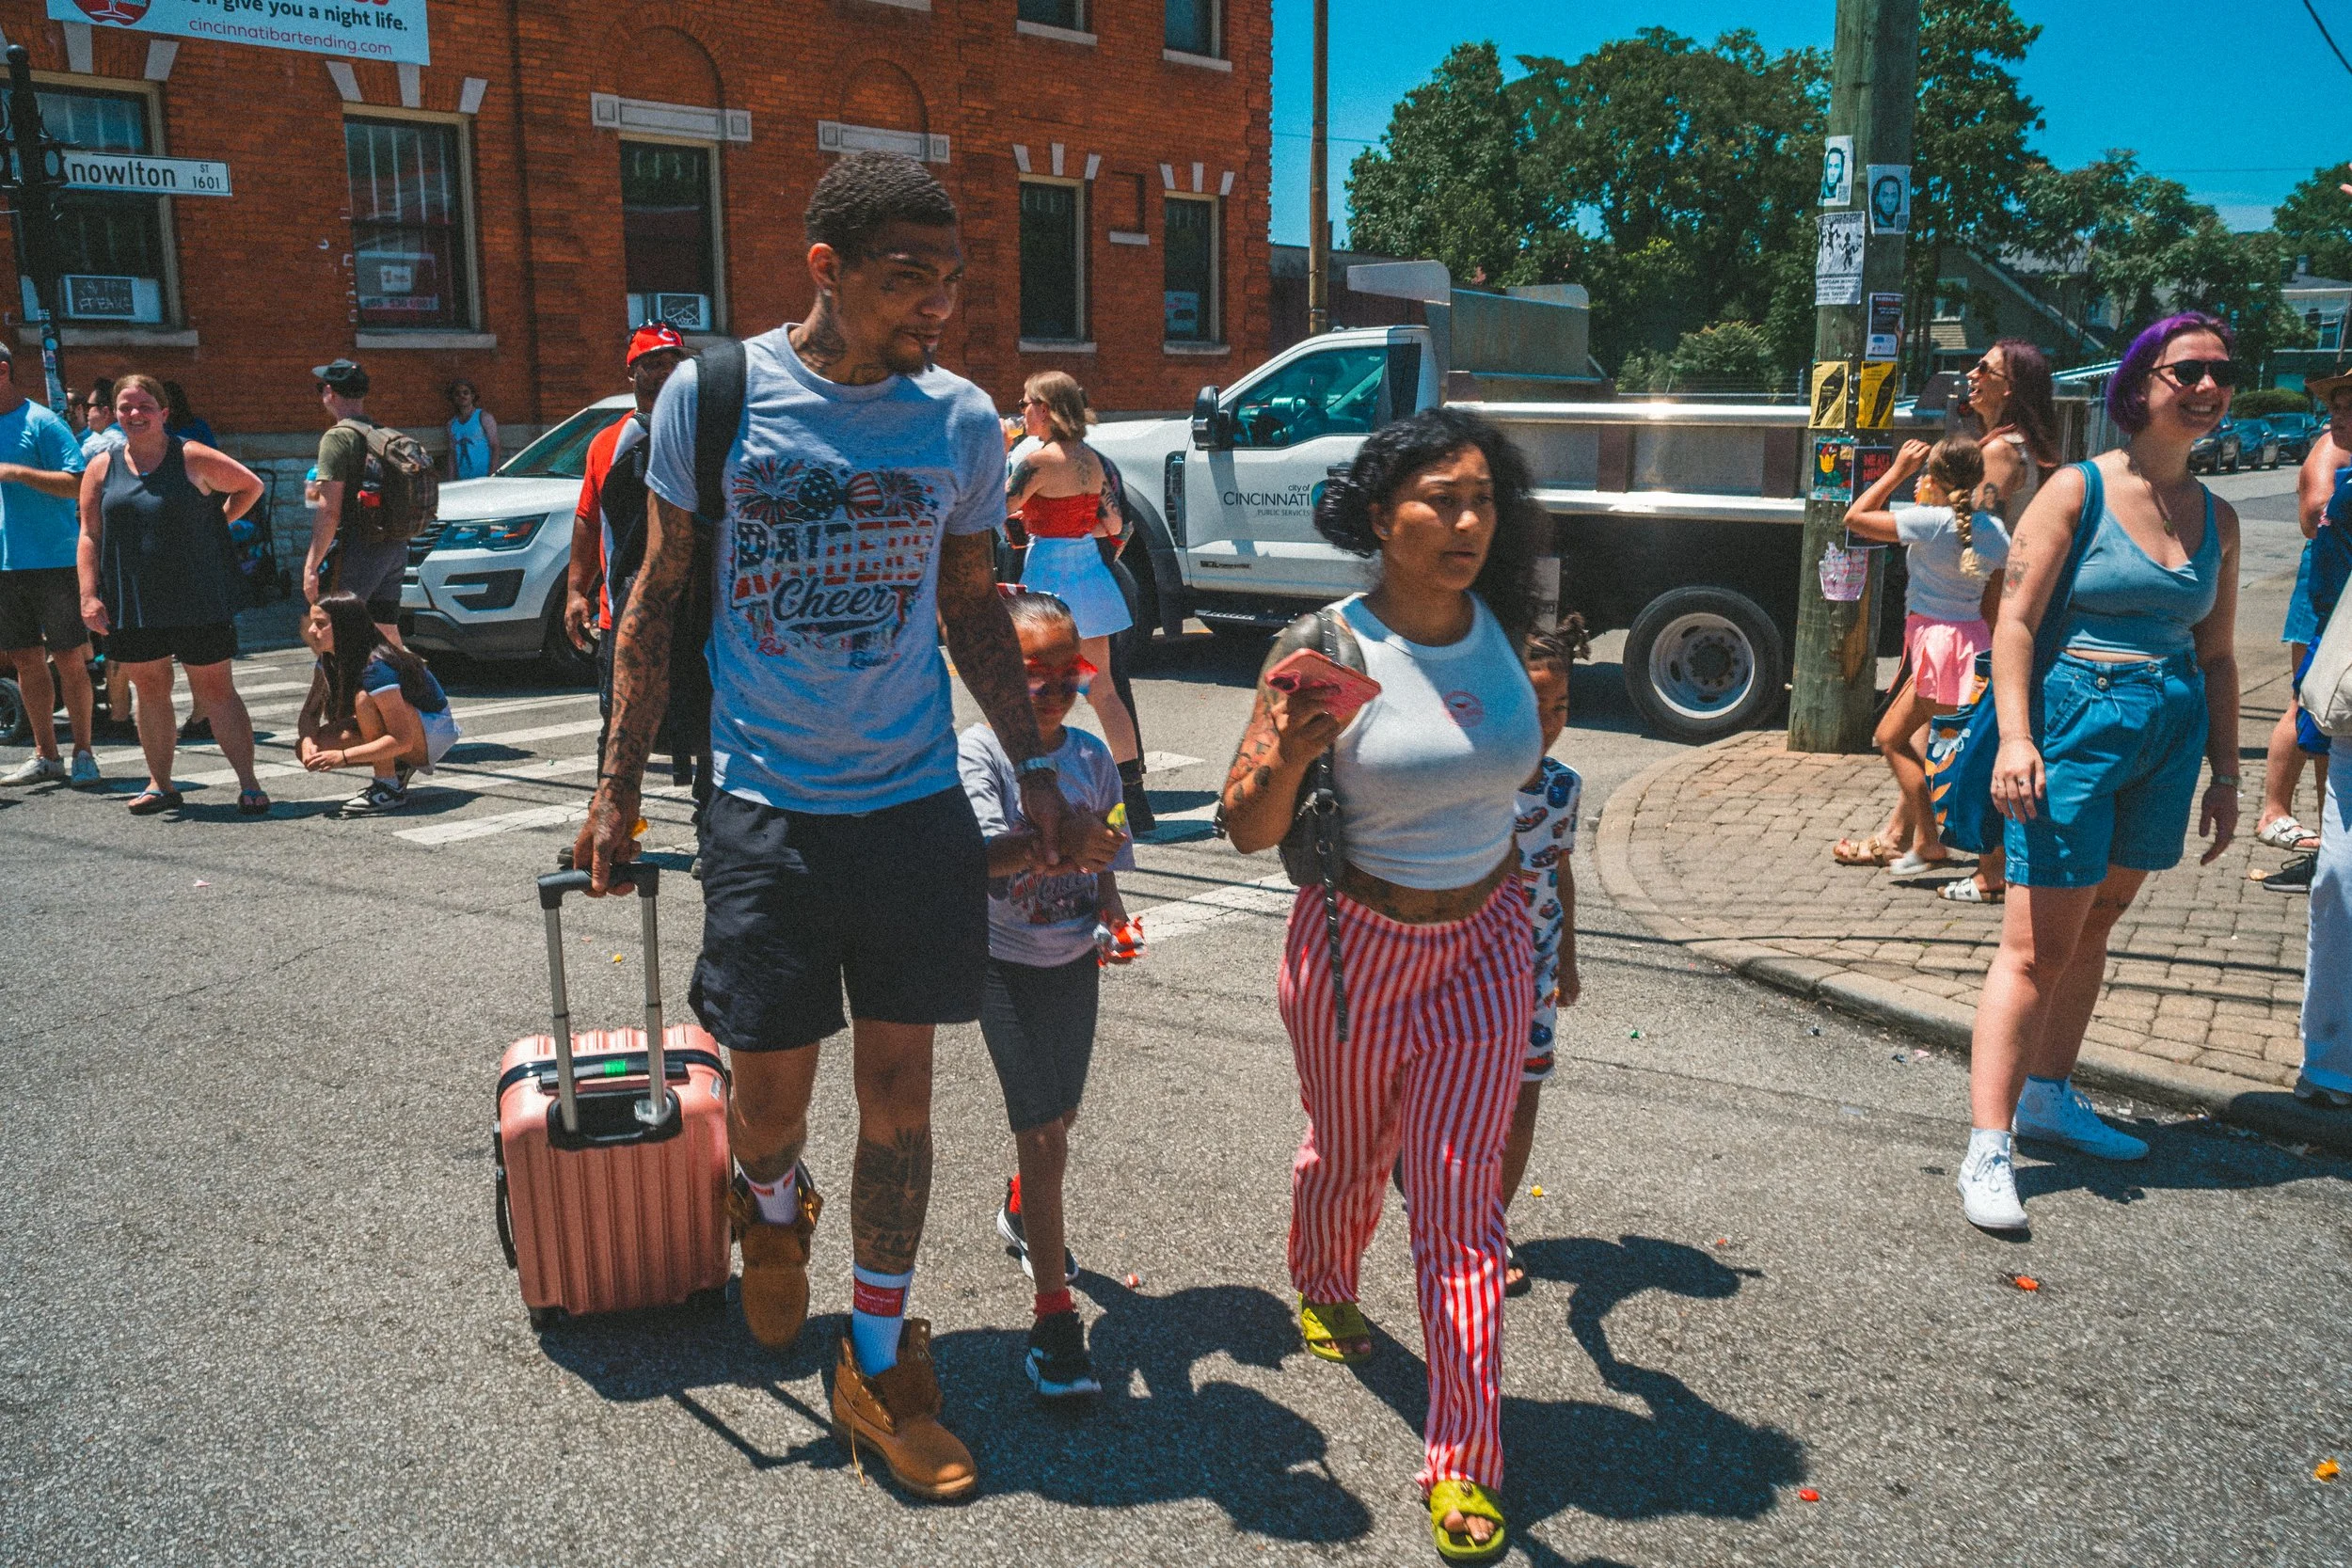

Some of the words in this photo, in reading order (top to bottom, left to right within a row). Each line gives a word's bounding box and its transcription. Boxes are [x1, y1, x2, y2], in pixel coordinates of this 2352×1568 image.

[268, 1, 304, 18] you
[309, 8, 319, 20] a
[325, 6, 371, 28] night
[375, 10, 407, 31] life.
[189, 18, 392, 55] cincinnatibartending.com
[65, 158, 176, 187] nowlton
[199, 164, 210, 174] ST
[192, 176, 220, 190] 1601
[1223, 491, 1310, 506] CINCINNATI
[1287, 483, 1302, 493] city
[1303, 483, 1311, 492] of
[772, 577, 898, 622] Cheer
